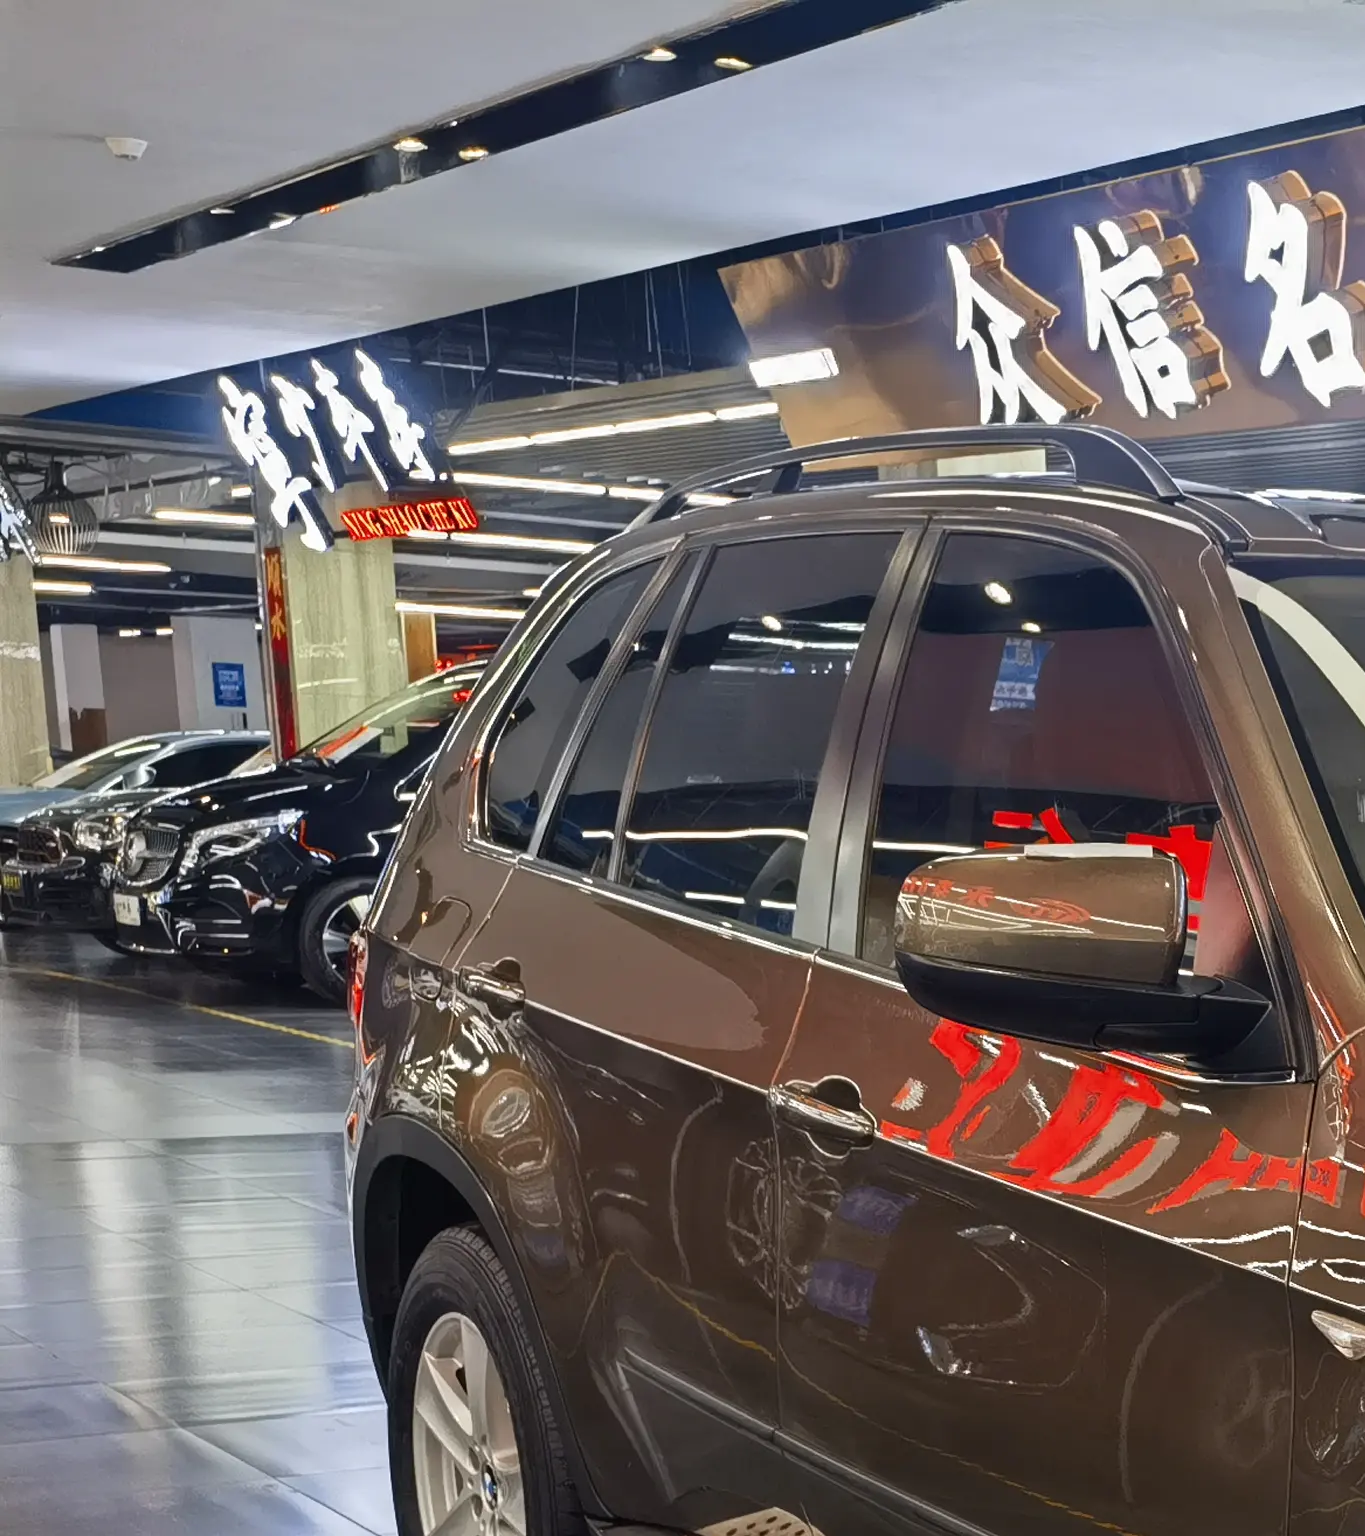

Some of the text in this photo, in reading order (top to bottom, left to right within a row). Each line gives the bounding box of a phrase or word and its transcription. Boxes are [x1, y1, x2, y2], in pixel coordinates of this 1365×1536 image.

[342, 497, 479, 540] NING SHAO CHE KU
